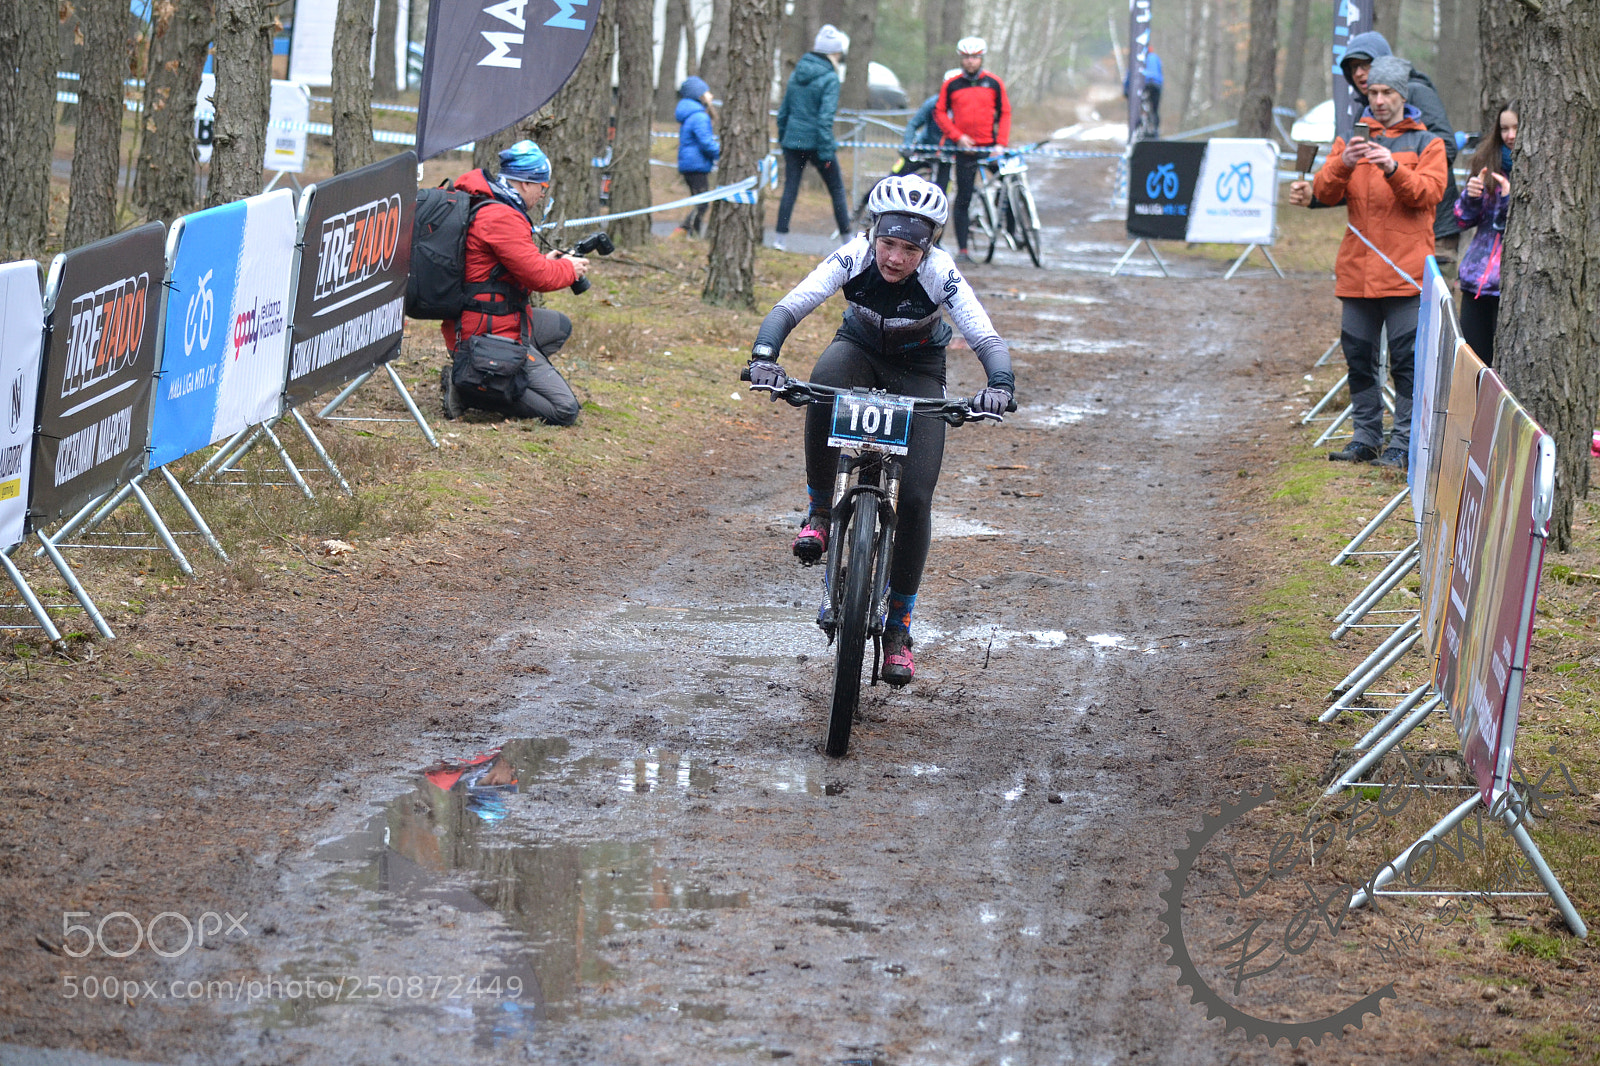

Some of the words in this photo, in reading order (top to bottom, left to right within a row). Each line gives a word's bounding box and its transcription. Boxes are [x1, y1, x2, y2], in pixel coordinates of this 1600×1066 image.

[317, 198, 401, 295] TREZADO
[64, 278, 148, 391] TREZADO
[849, 404, 894, 435] 101
